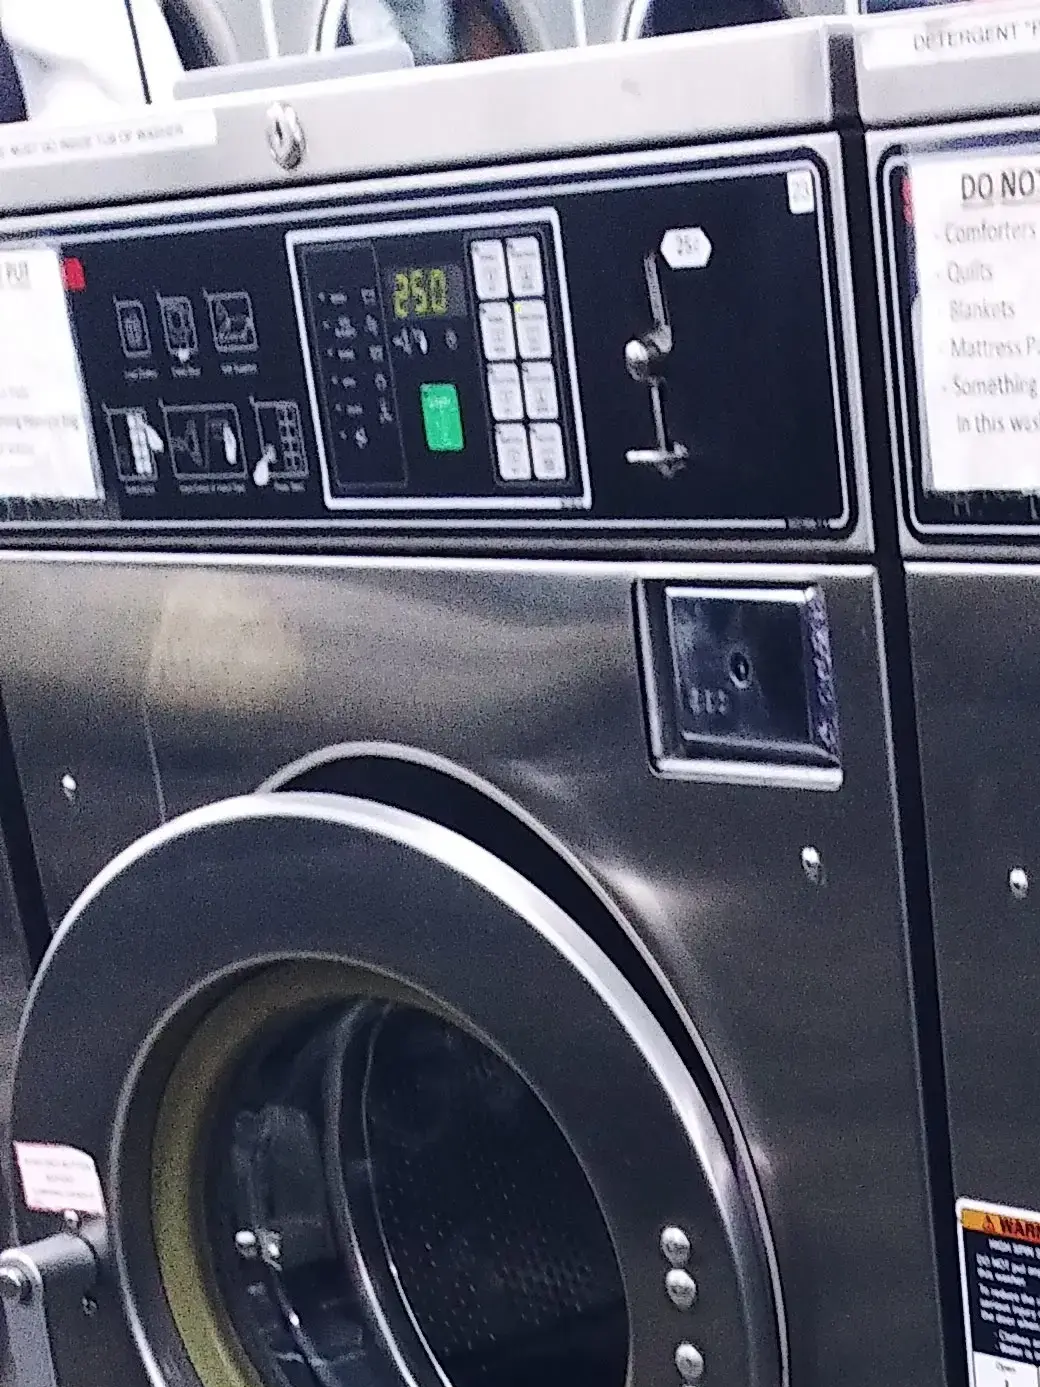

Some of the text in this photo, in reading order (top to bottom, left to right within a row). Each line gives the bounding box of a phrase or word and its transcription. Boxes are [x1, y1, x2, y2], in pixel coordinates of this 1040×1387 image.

[913, 20, 1018, 51] DETERGENT
[961, 172, 993, 201] DO
[944, 216, 1036, 244] Comforters
[947, 259, 993, 284] Quilts
[950, 298, 1016, 322] Blankets
[950, 336, 1021, 358] Mattress
[952, 372, 1038, 400] Something
[975, 412, 1005, 434] this
[995, 1361, 1016, 1373] Open
